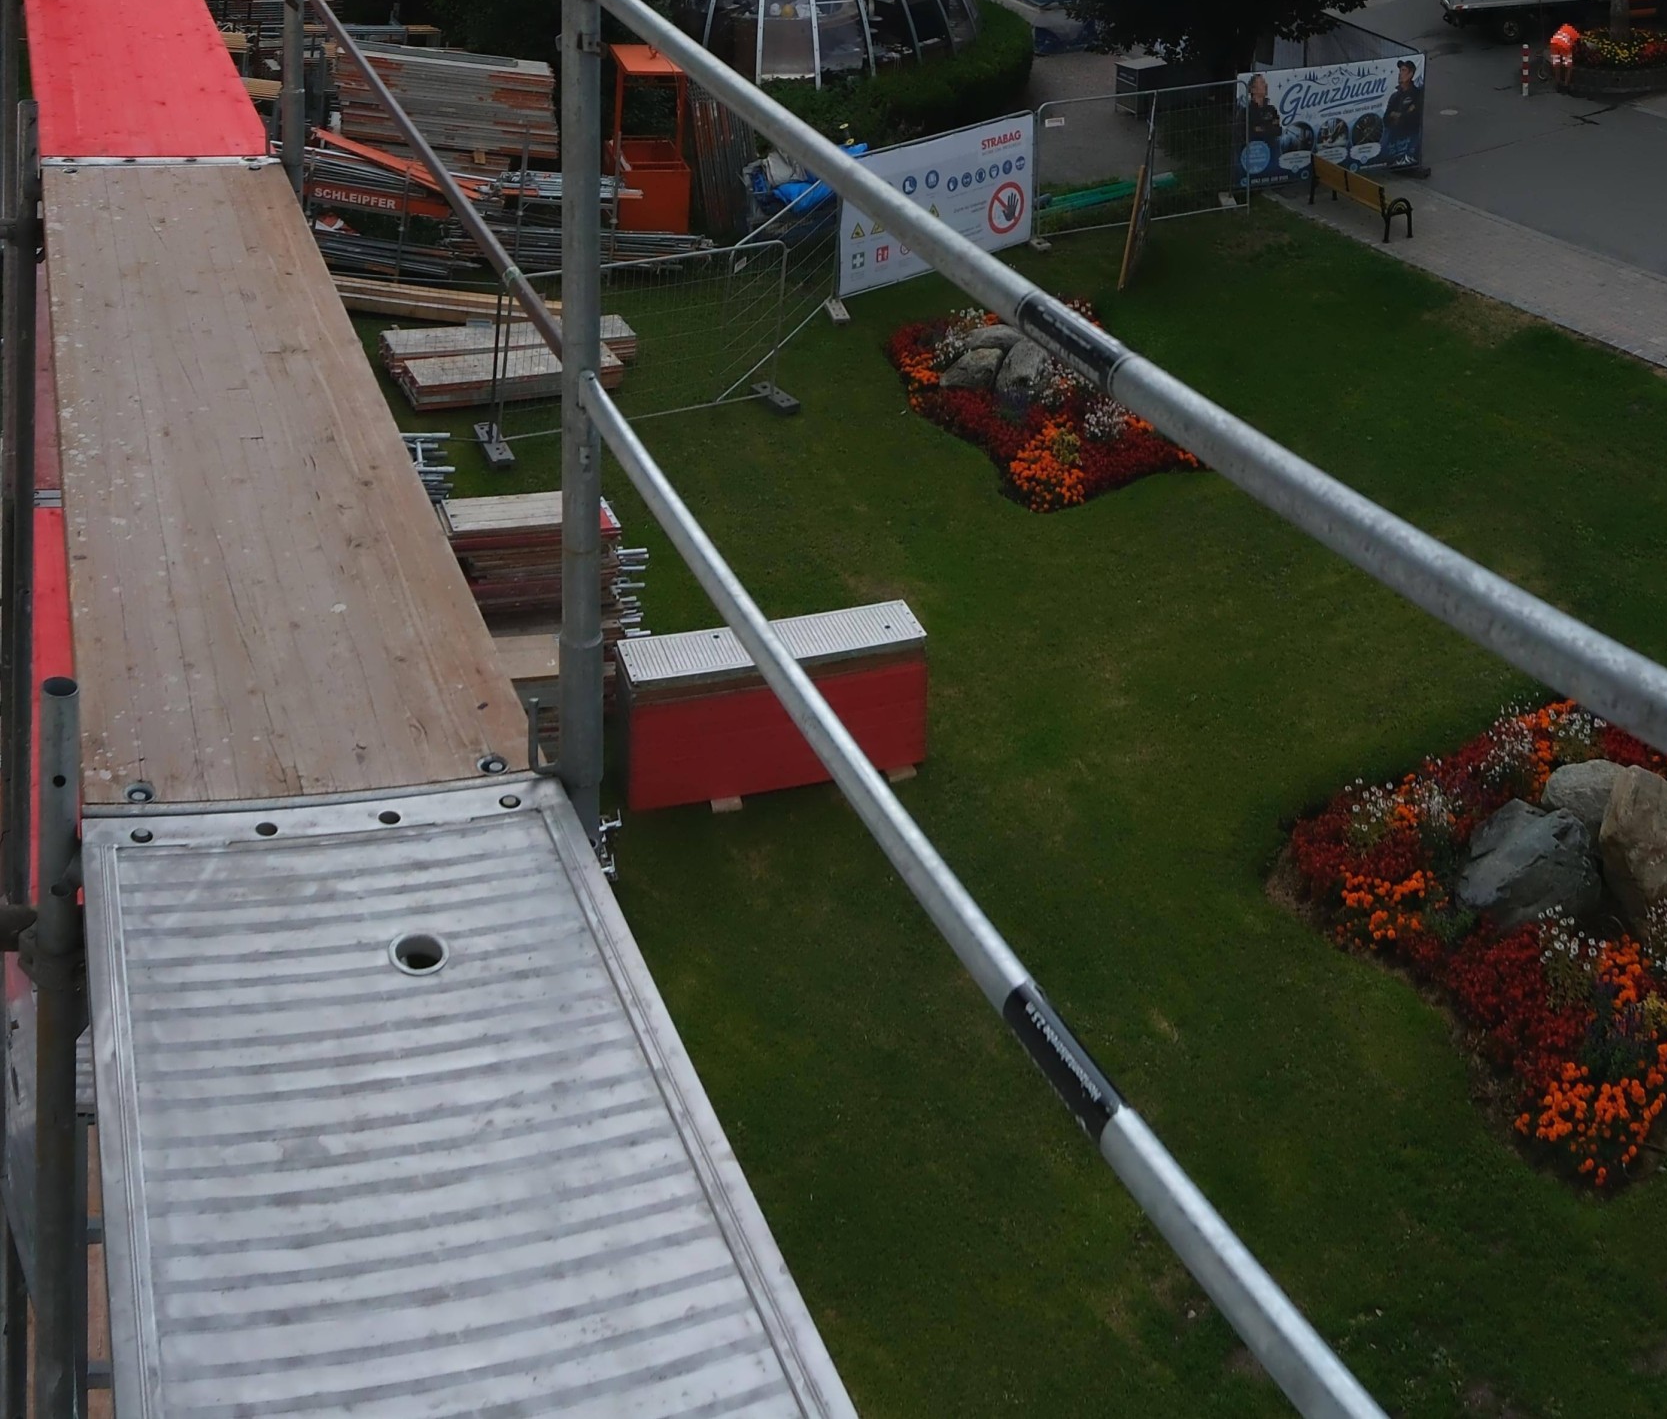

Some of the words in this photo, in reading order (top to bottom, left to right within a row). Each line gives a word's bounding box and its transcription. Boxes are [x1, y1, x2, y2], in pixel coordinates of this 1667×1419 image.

[1280, 75, 1388, 123] Glanzbuam
[981, 130, 1021, 150] STRABAG
[314, 186, 396, 209] SCHLEIPFER
